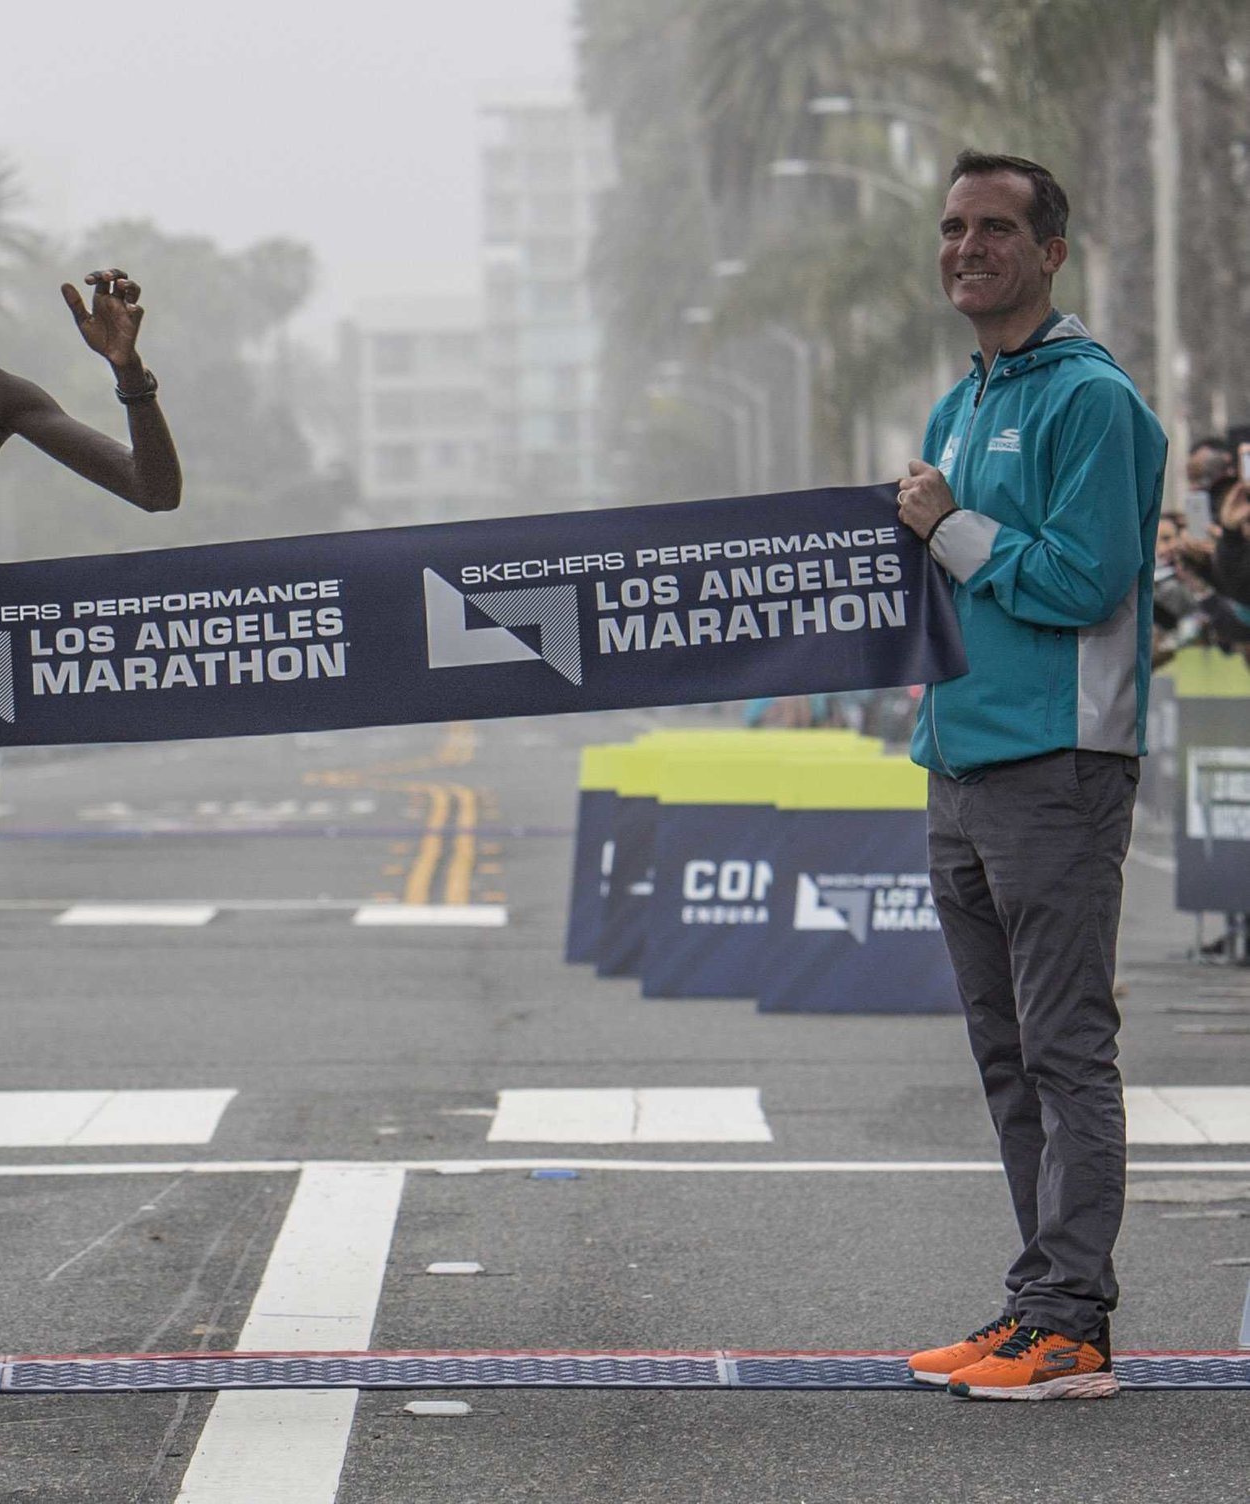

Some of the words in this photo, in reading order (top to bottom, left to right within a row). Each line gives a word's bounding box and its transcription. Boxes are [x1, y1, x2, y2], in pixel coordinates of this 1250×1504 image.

[461, 552, 626, 585] SKECHERS
[636, 527, 897, 568] PERFORMANCE
[73, 579, 340, 618] PERFORMANCE
[595, 574, 680, 611] LOS
[699, 554, 901, 601] ANGELES
[30, 625, 115, 656] LOS
[134, 607, 344, 651] ANGELES
[598, 590, 906, 654] MARATHON
[32, 642, 347, 695] MARATHON
[872, 908, 942, 931] MAR
[874, 888, 919, 908] LOS
